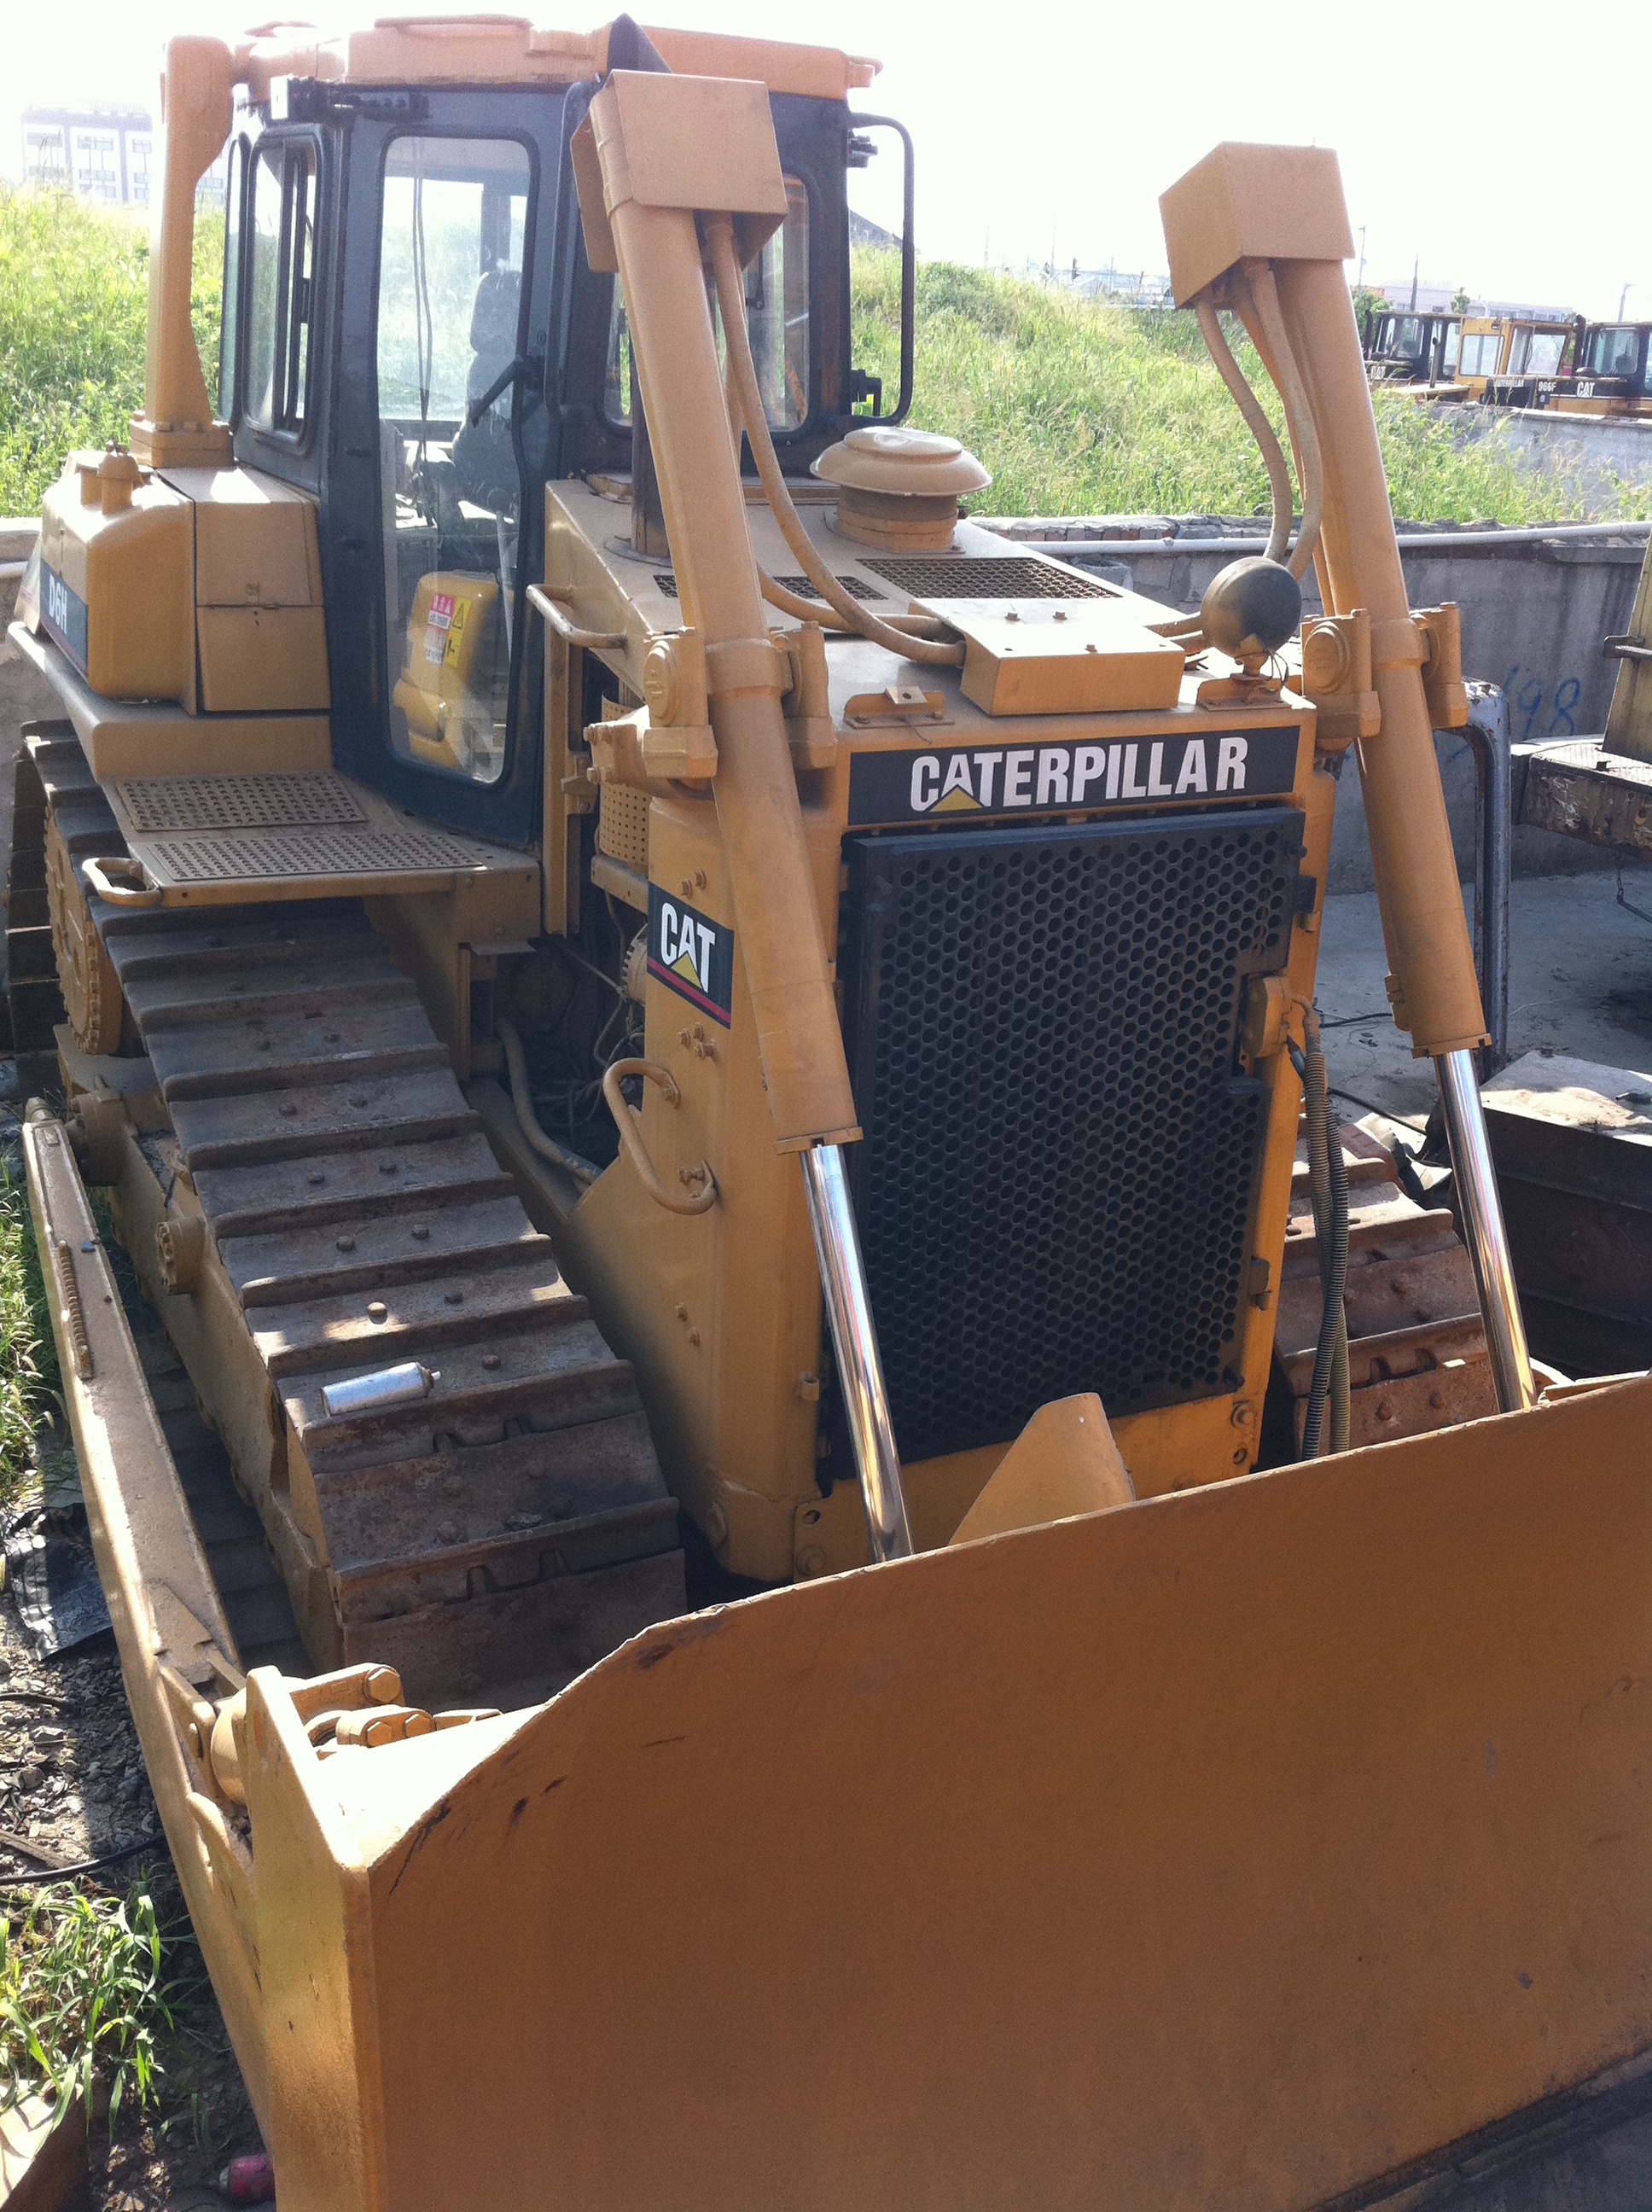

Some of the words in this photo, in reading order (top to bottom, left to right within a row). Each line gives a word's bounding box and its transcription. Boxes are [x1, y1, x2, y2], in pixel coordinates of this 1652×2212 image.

[1538, 381, 1557, 393] 966F
[1576, 381, 1596, 398] CAT
[49, 573, 68, 634] D6H
[910, 736, 1249, 812] CATERPILLAR
[660, 901, 716, 993] CAT
